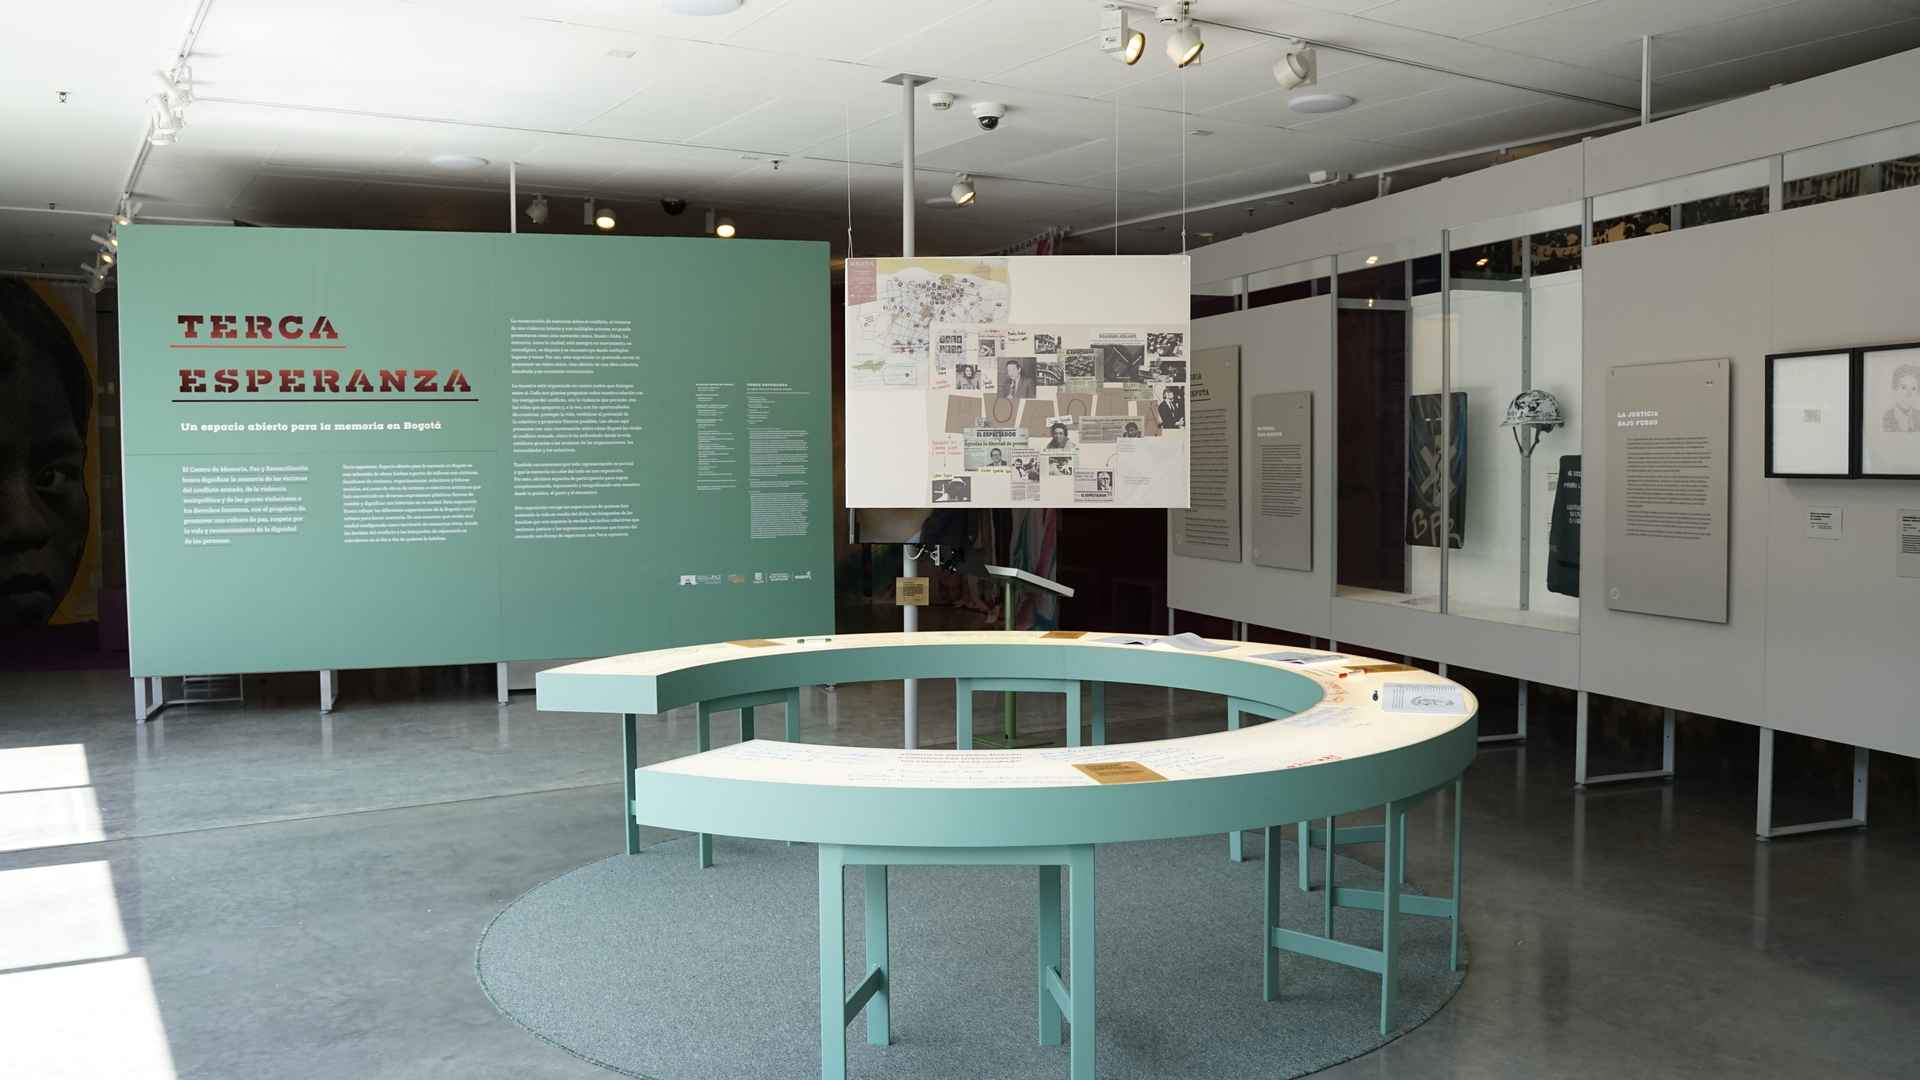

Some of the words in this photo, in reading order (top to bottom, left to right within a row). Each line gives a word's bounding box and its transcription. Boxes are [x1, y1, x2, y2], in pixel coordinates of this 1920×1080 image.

[177, 315, 338, 339] TERCA
[179, 369, 472, 393] ESPERANZA
[181, 422, 198, 431] Un
[201, 421, 245, 433] espacio
[247, 421, 288, 432] abierto
[291, 424, 318, 433] para
[320, 422, 332, 431] la
[334, 421, 385, 431] memoria
[387, 423, 400, 431] en
[403, 420, 442, 432] Bogotá
